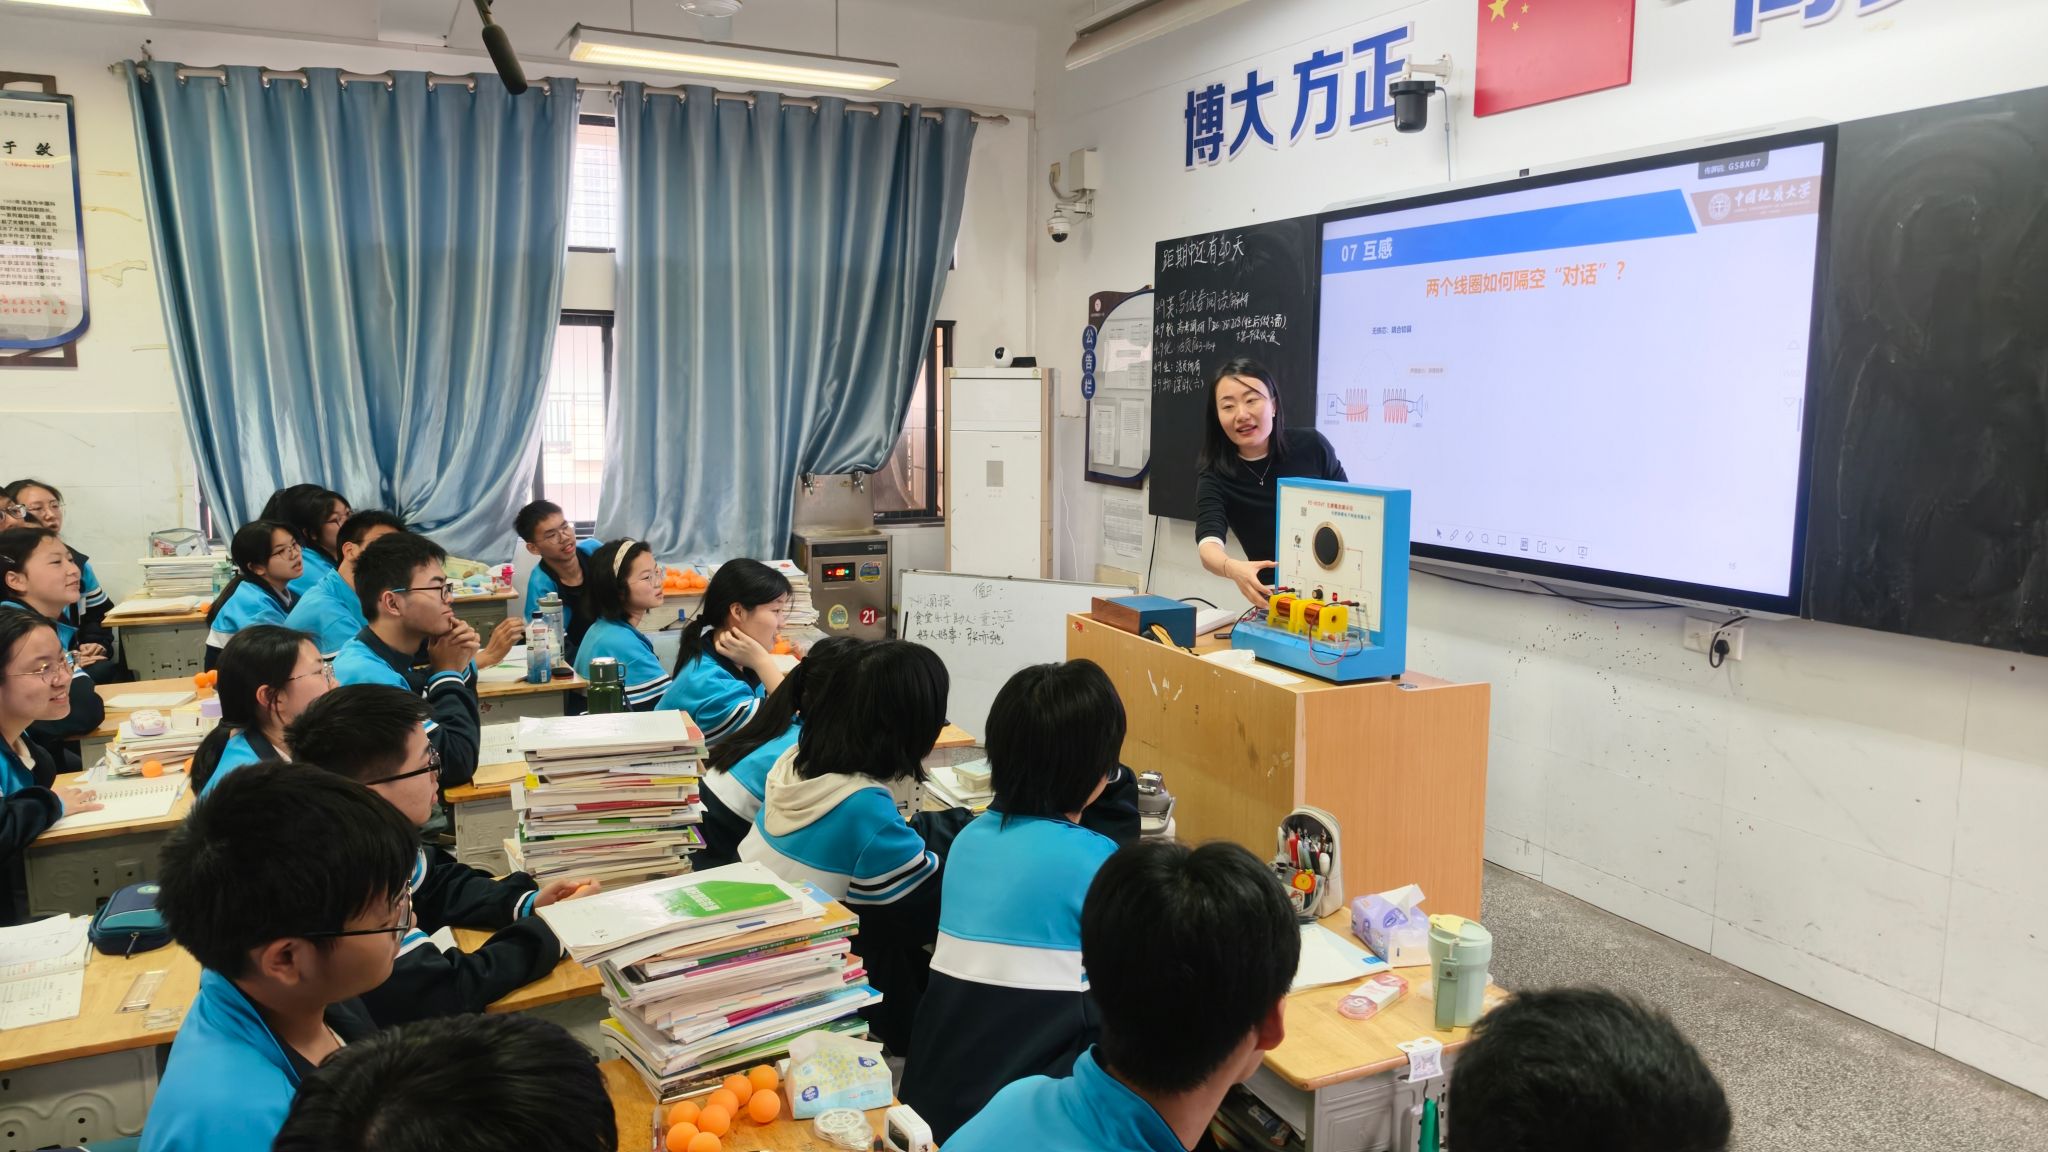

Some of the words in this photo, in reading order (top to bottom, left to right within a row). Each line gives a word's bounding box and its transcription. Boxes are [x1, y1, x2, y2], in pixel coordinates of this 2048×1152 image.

[1185, 26, 1407, 167] 博大方正
[1735, 181, 1811, 207] 中国地质大学
[1341, 245, 1357, 262] 07
[1363, 237, 1393, 261] 互感
[1426, 261, 1626, 298] 两个线圈如何隔空“对话”？
[1085, 328, 1095, 394] 公告栏
[862, 610, 875, 624] 21
